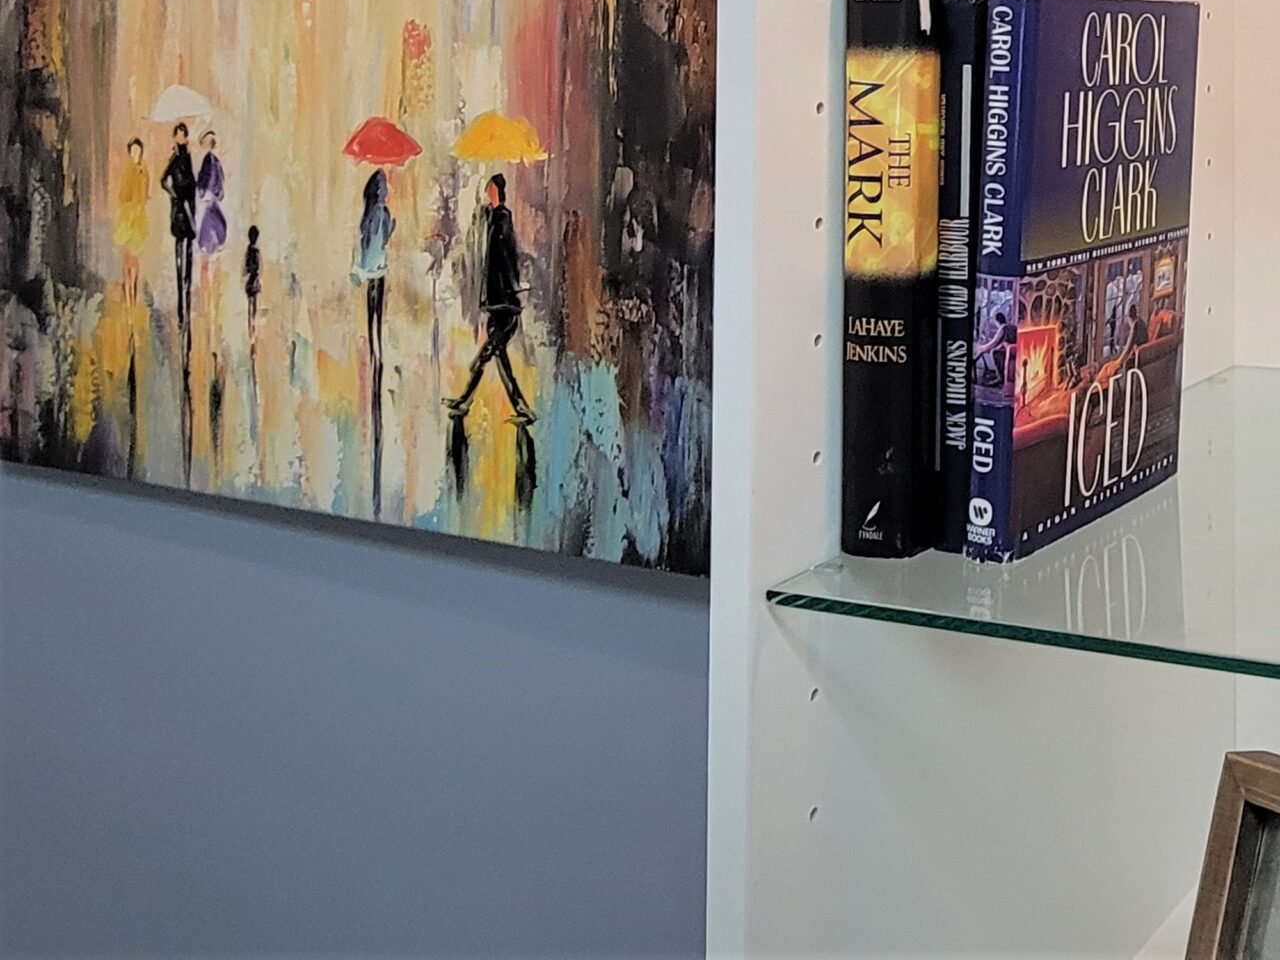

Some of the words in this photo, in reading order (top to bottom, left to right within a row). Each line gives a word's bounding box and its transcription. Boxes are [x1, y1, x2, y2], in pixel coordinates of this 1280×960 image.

[990, 5, 1013, 78] CAROL
[1082, 12, 1168, 88] CAROL
[985, 85, 1009, 176] HIGGINS
[1061, 86, 1178, 168] HIGGINS
[847, 80, 885, 248] MARK
[888, 133, 911, 189] THE
[982, 183, 1005, 266] CLARK
[1082, 159, 1158, 243] CLARK
[938, 218, 970, 280] HARBOUR
[1026, 263, 1043, 273] NEW
[848, 316, 905, 338] LAHAYE
[938, 285, 969, 319] COLD
[846, 342, 907, 363] JENKINS
[946, 340, 967, 405] HIGGINS
[946, 410, 967, 451] JACK
[972, 417, 994, 474] ICED
[1063, 368, 1148, 507] ICED
[967, 531, 993, 546] BOOKS
